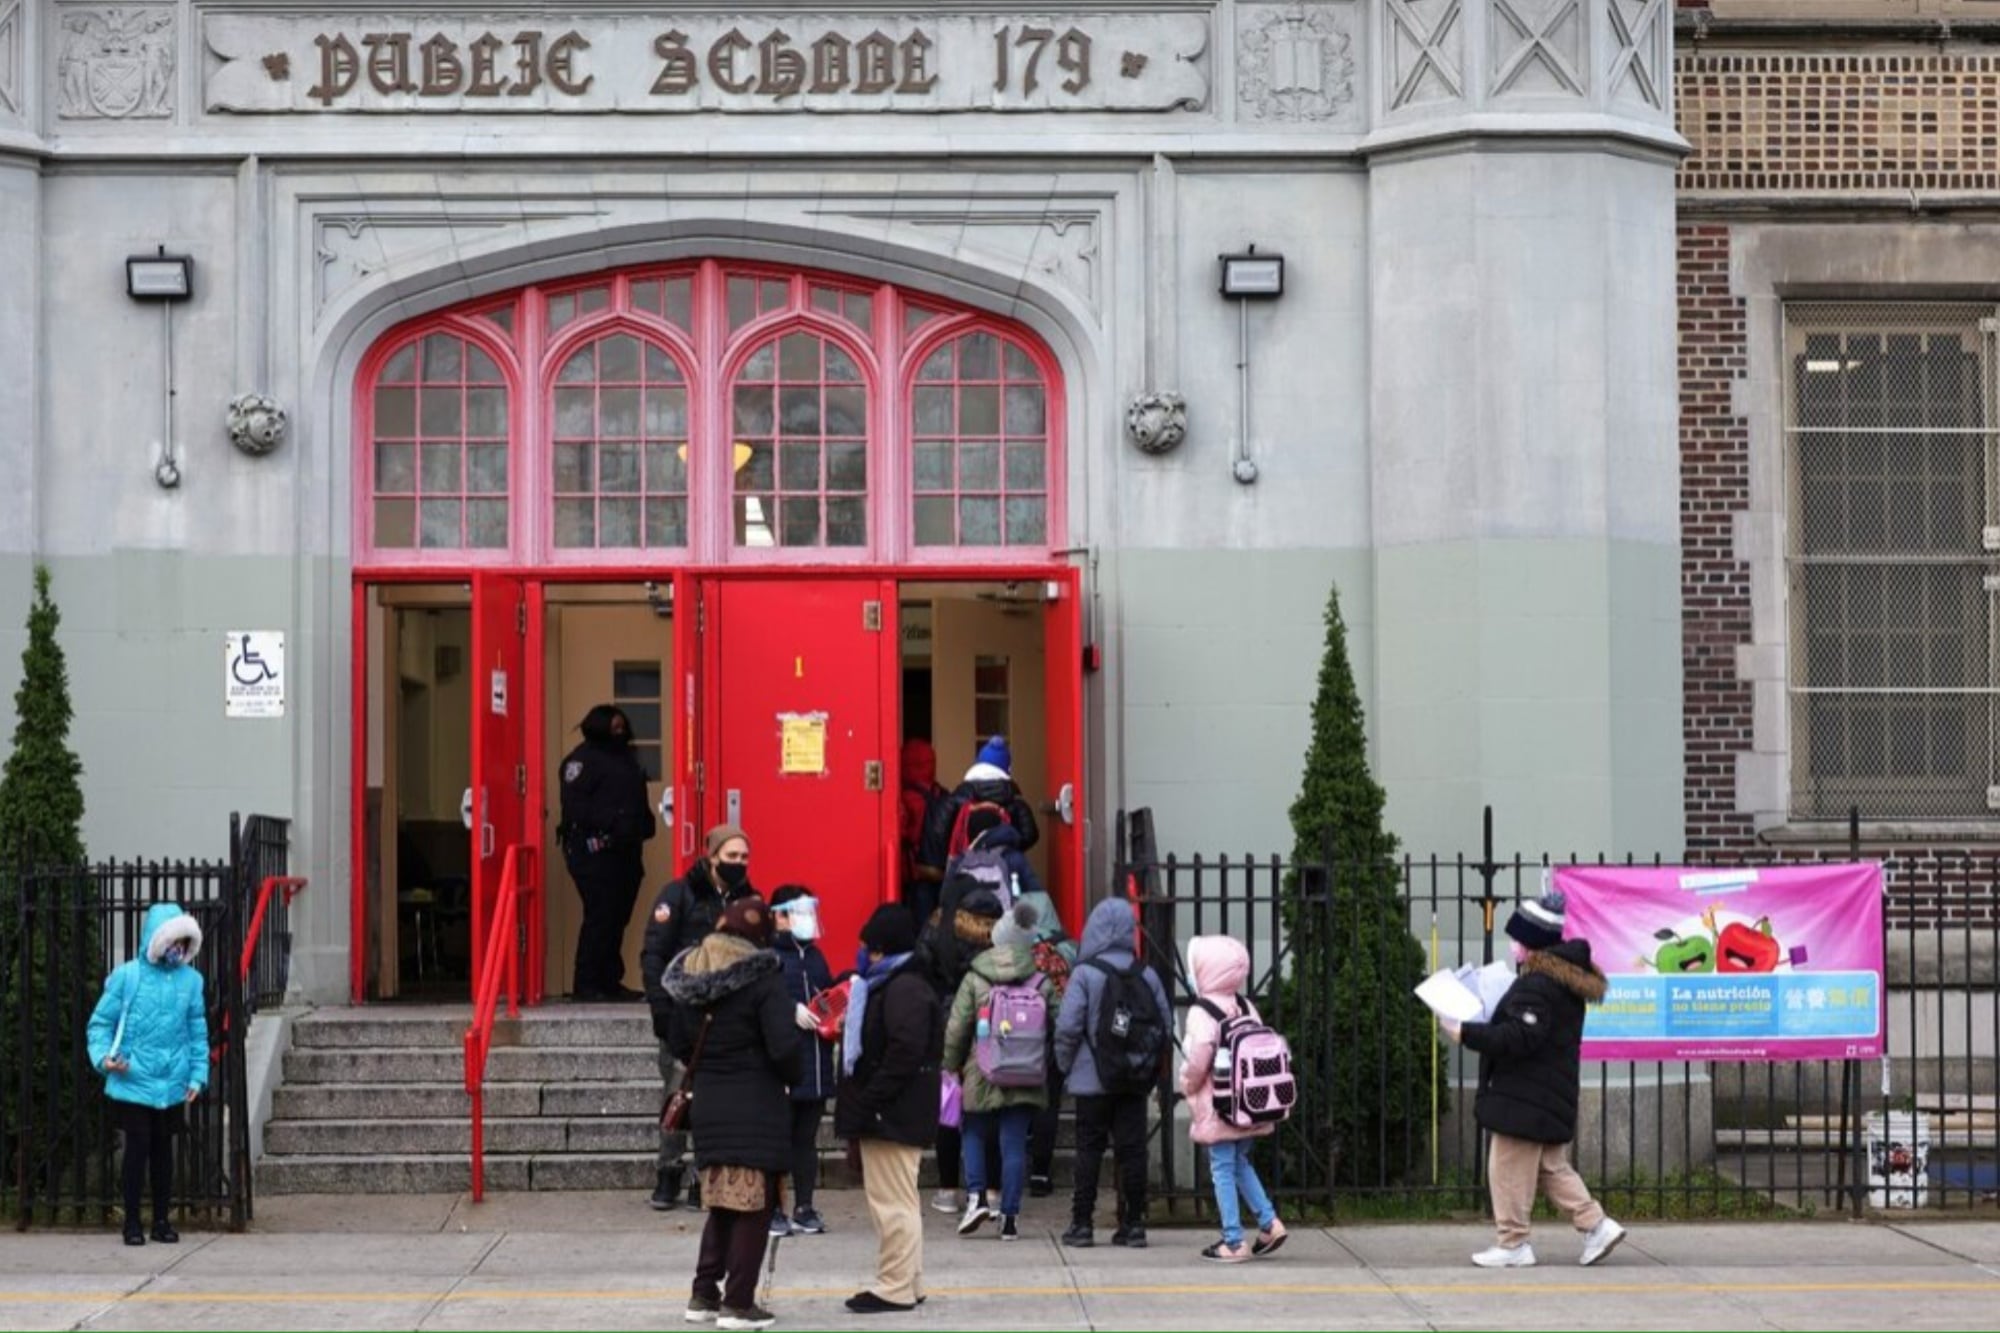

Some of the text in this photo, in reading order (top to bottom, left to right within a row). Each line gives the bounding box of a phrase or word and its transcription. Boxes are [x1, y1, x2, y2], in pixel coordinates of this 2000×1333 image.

[307, 25, 1092, 106] PUBLIC SCHOOL 179
[795, 656, 803, 677] 1
[1672, 987, 1692, 1000] La
[1696, 986, 1771, 999] nutrición
